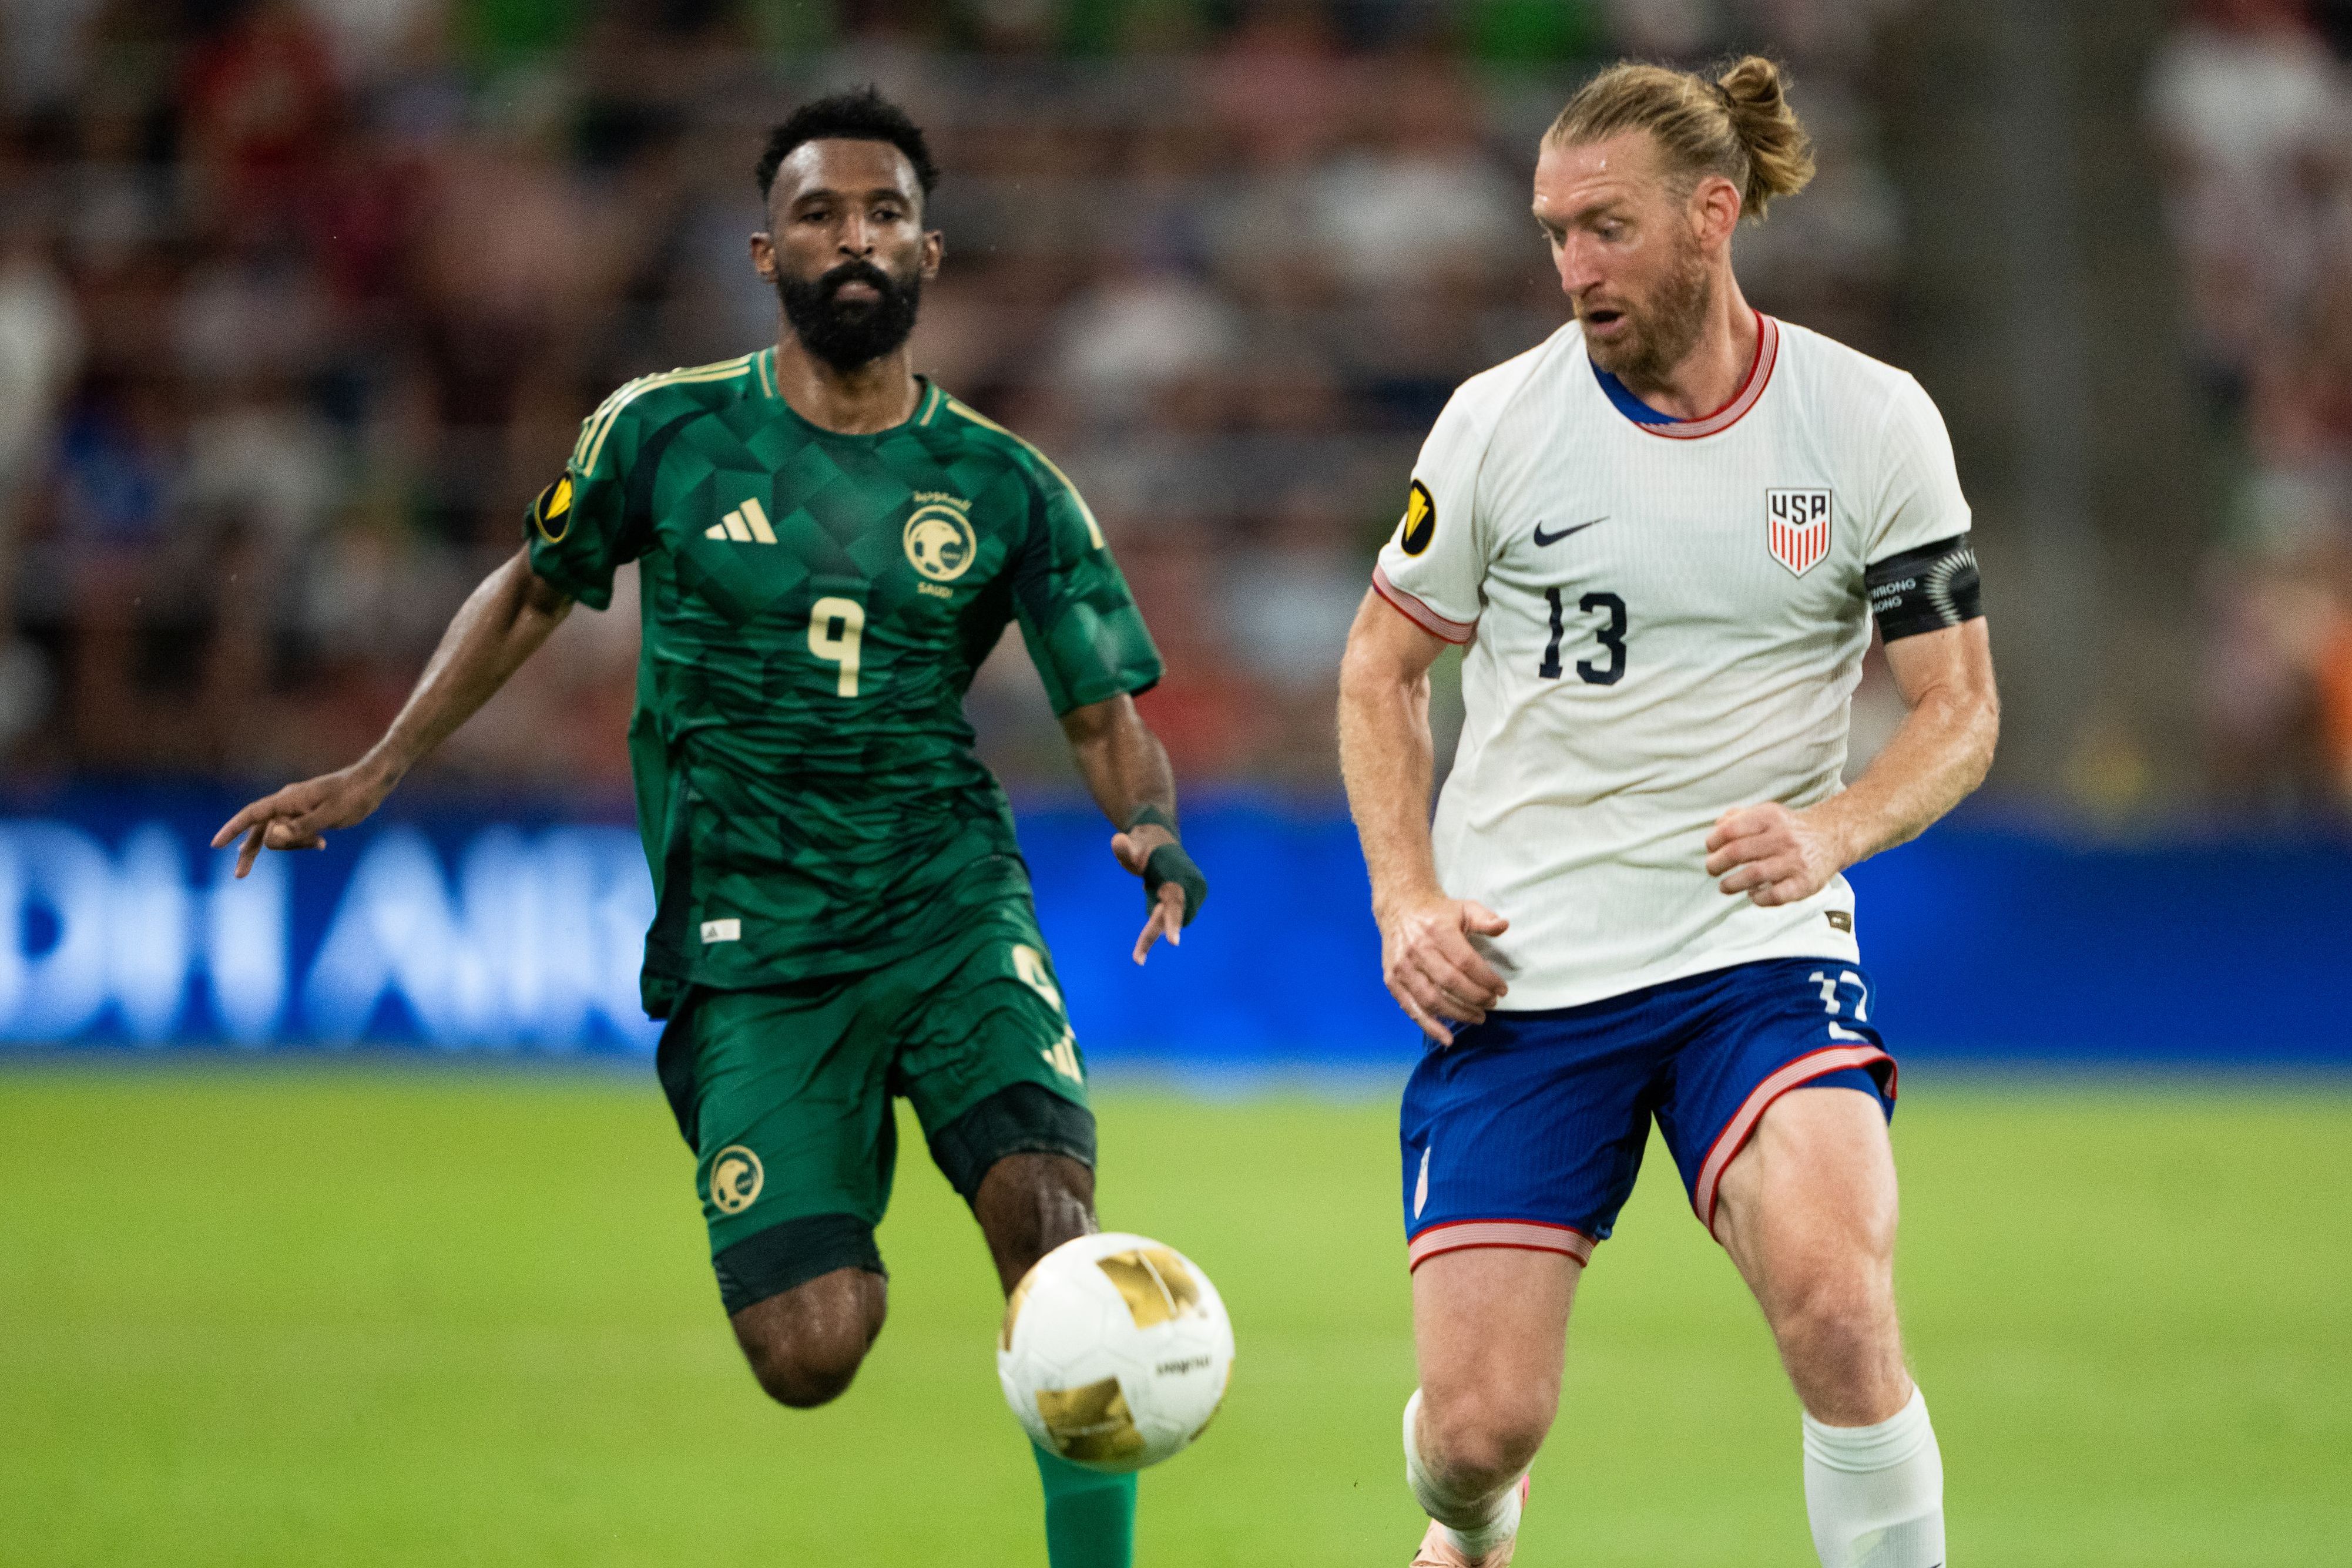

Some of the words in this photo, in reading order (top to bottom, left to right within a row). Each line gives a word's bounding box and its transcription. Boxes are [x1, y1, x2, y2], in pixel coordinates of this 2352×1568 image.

[1771, 495, 1826, 525] USA
[917, 582, 953, 598] SAUDI
[808, 596, 865, 697] 9
[1538, 587, 1627, 686] 13
